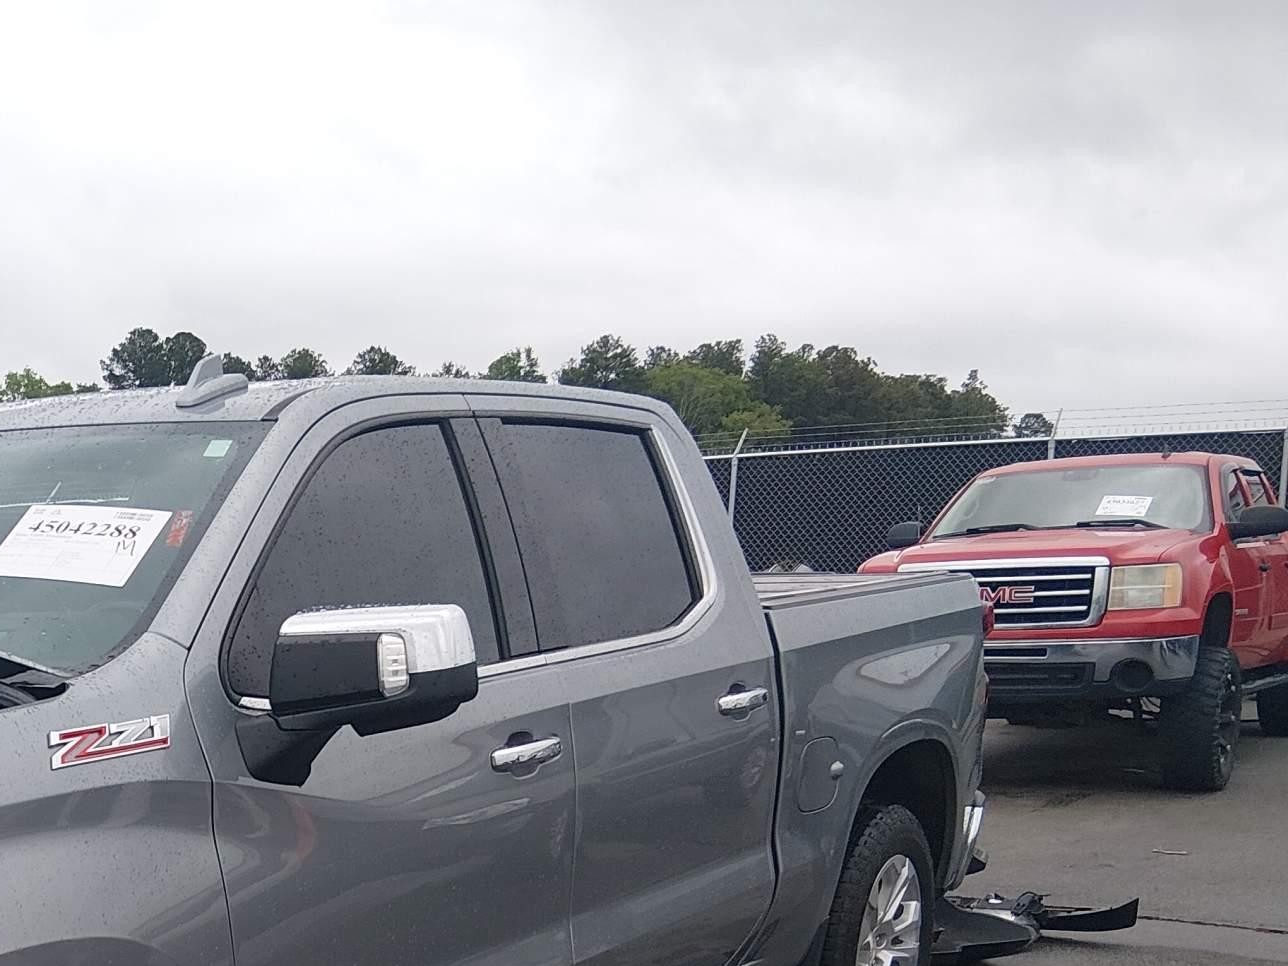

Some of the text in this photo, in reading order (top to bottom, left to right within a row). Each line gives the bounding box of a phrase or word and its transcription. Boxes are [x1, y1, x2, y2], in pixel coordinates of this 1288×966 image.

[28, 519, 141, 540] 45042288
[978, 585, 1035, 604] MC
[48, 714, 170, 770] Z71
